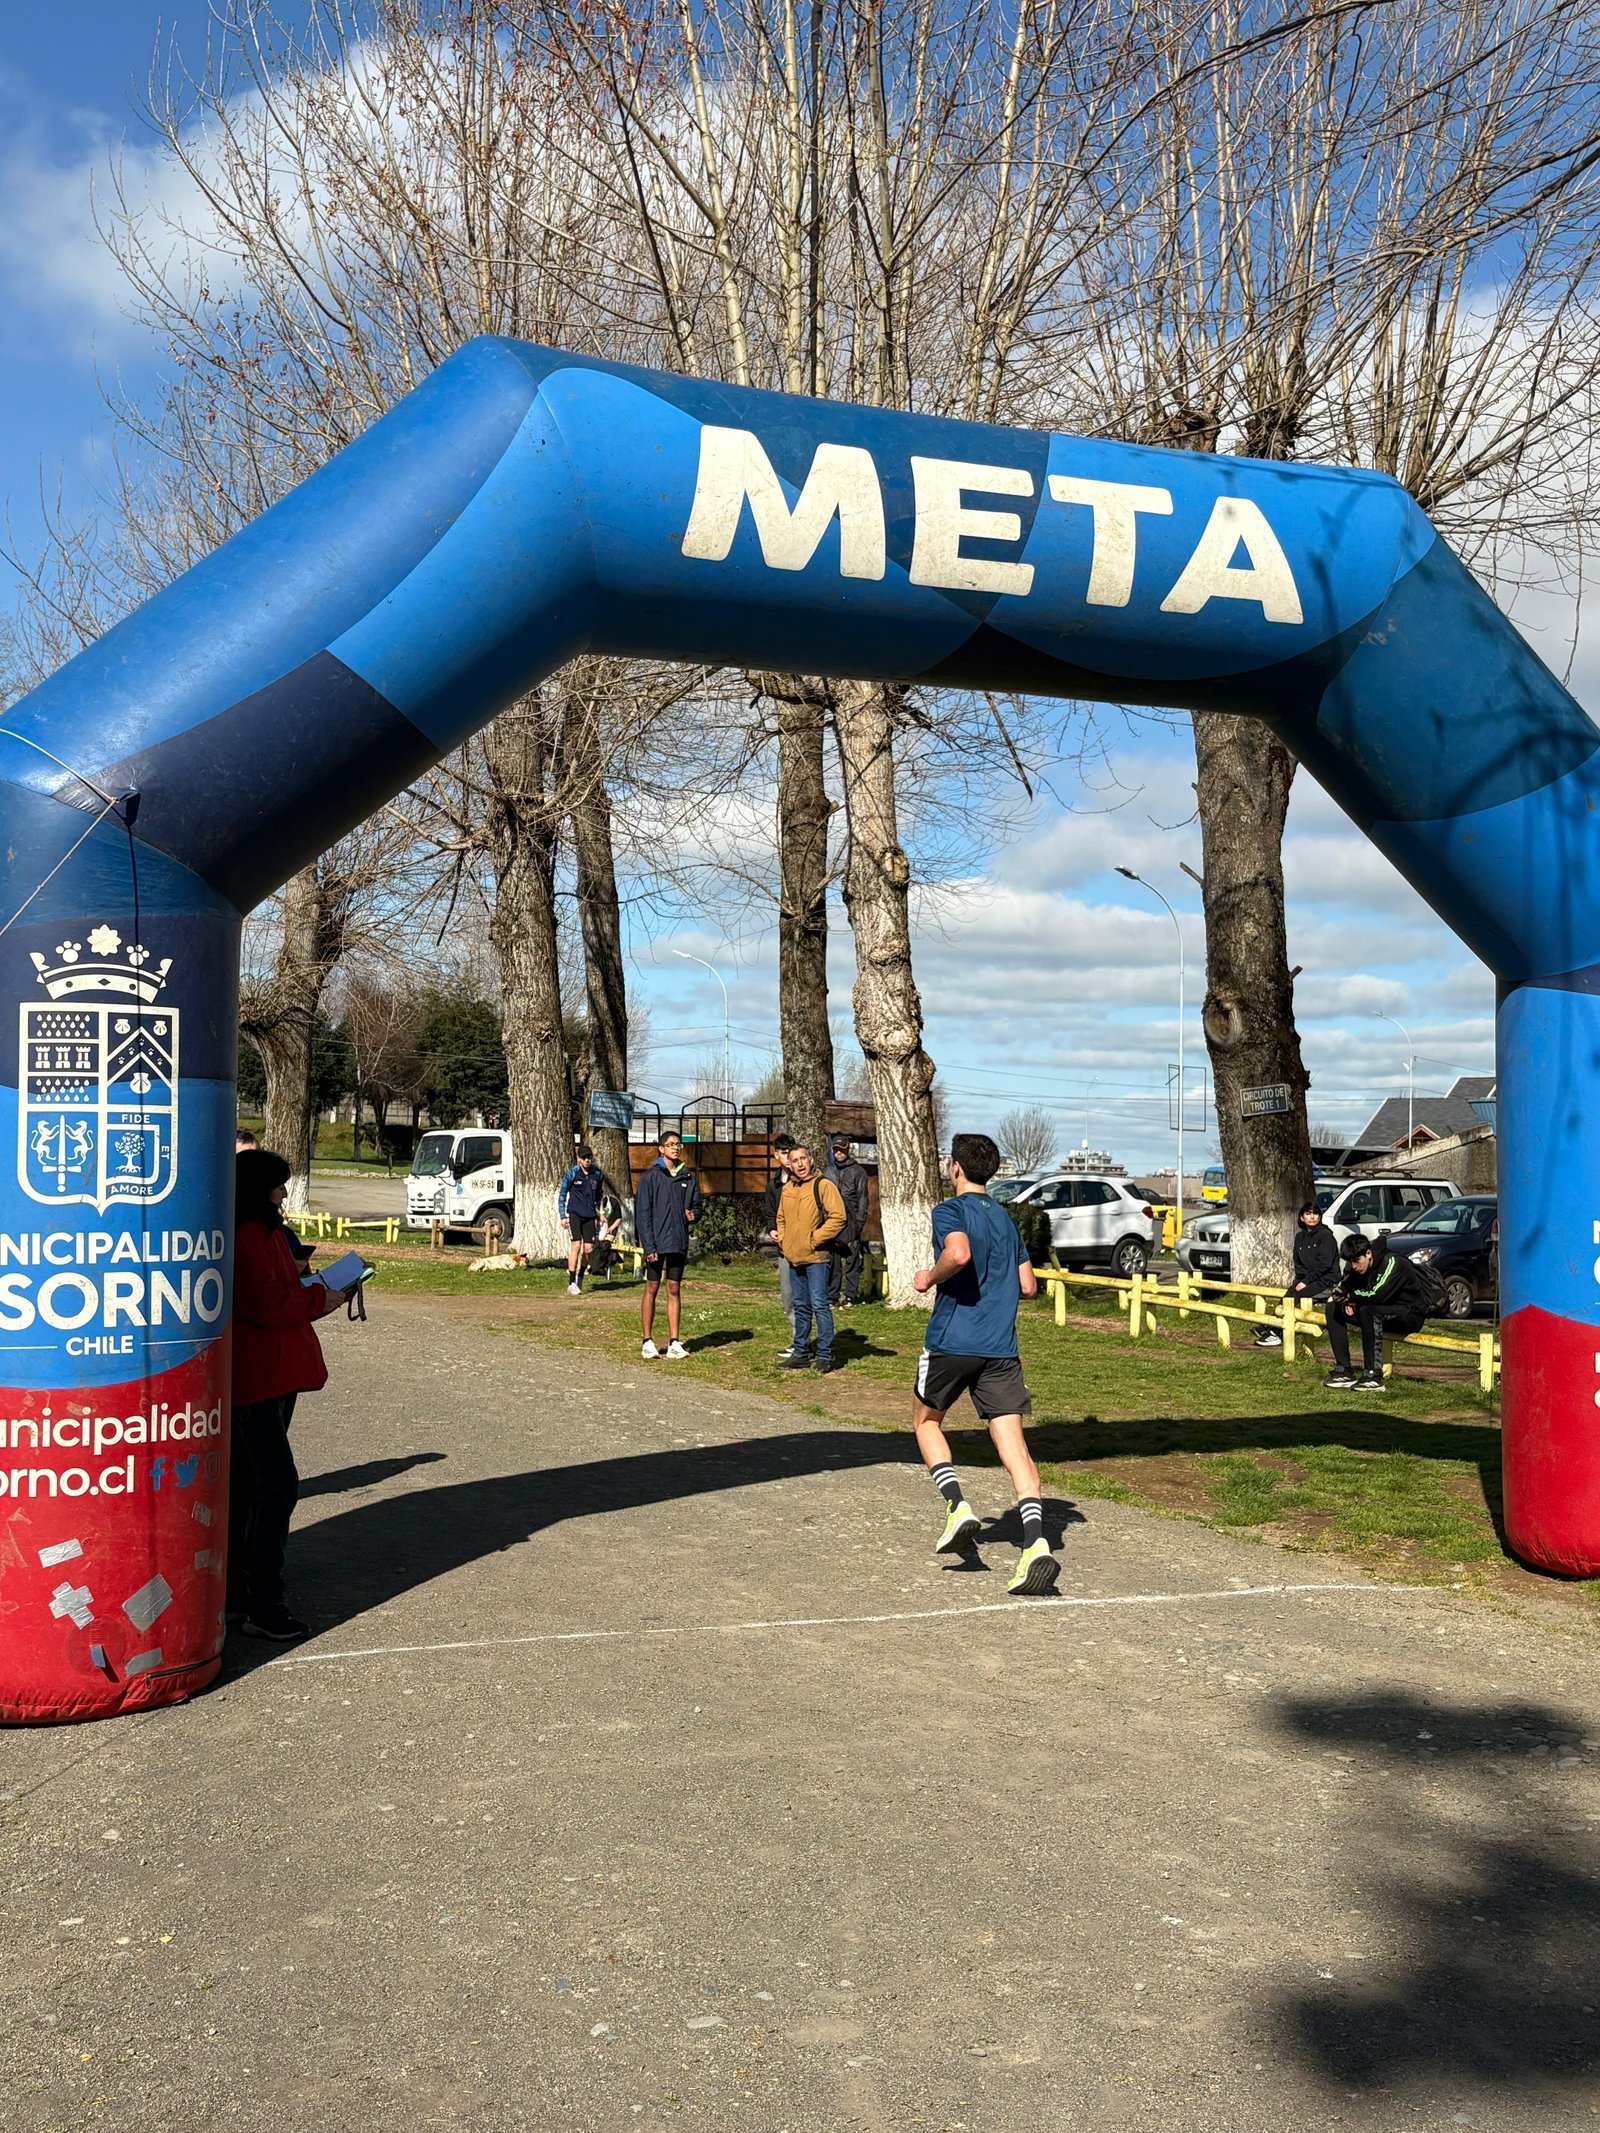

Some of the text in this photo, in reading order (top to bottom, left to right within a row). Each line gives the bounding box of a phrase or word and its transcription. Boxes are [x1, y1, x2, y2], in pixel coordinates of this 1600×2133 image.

[681, 425, 1304, 625] META
[1242, 1087, 1285, 1101] CIRCUITO DE
[1250, 1100, 1280, 1111] TROTE 1
[121, 1113, 150, 1123] FIDE
[161, 1145, 169, 1160] ET
[111, 1184, 153, 1195] AMORE
[0, 1230, 225, 1266] NICIPALIDAD
[0, 1267, 224, 1331] SORNO
[65, 1335, 134, 1356] CHILE
[0, 1398, 222, 1456] nicipalidad
